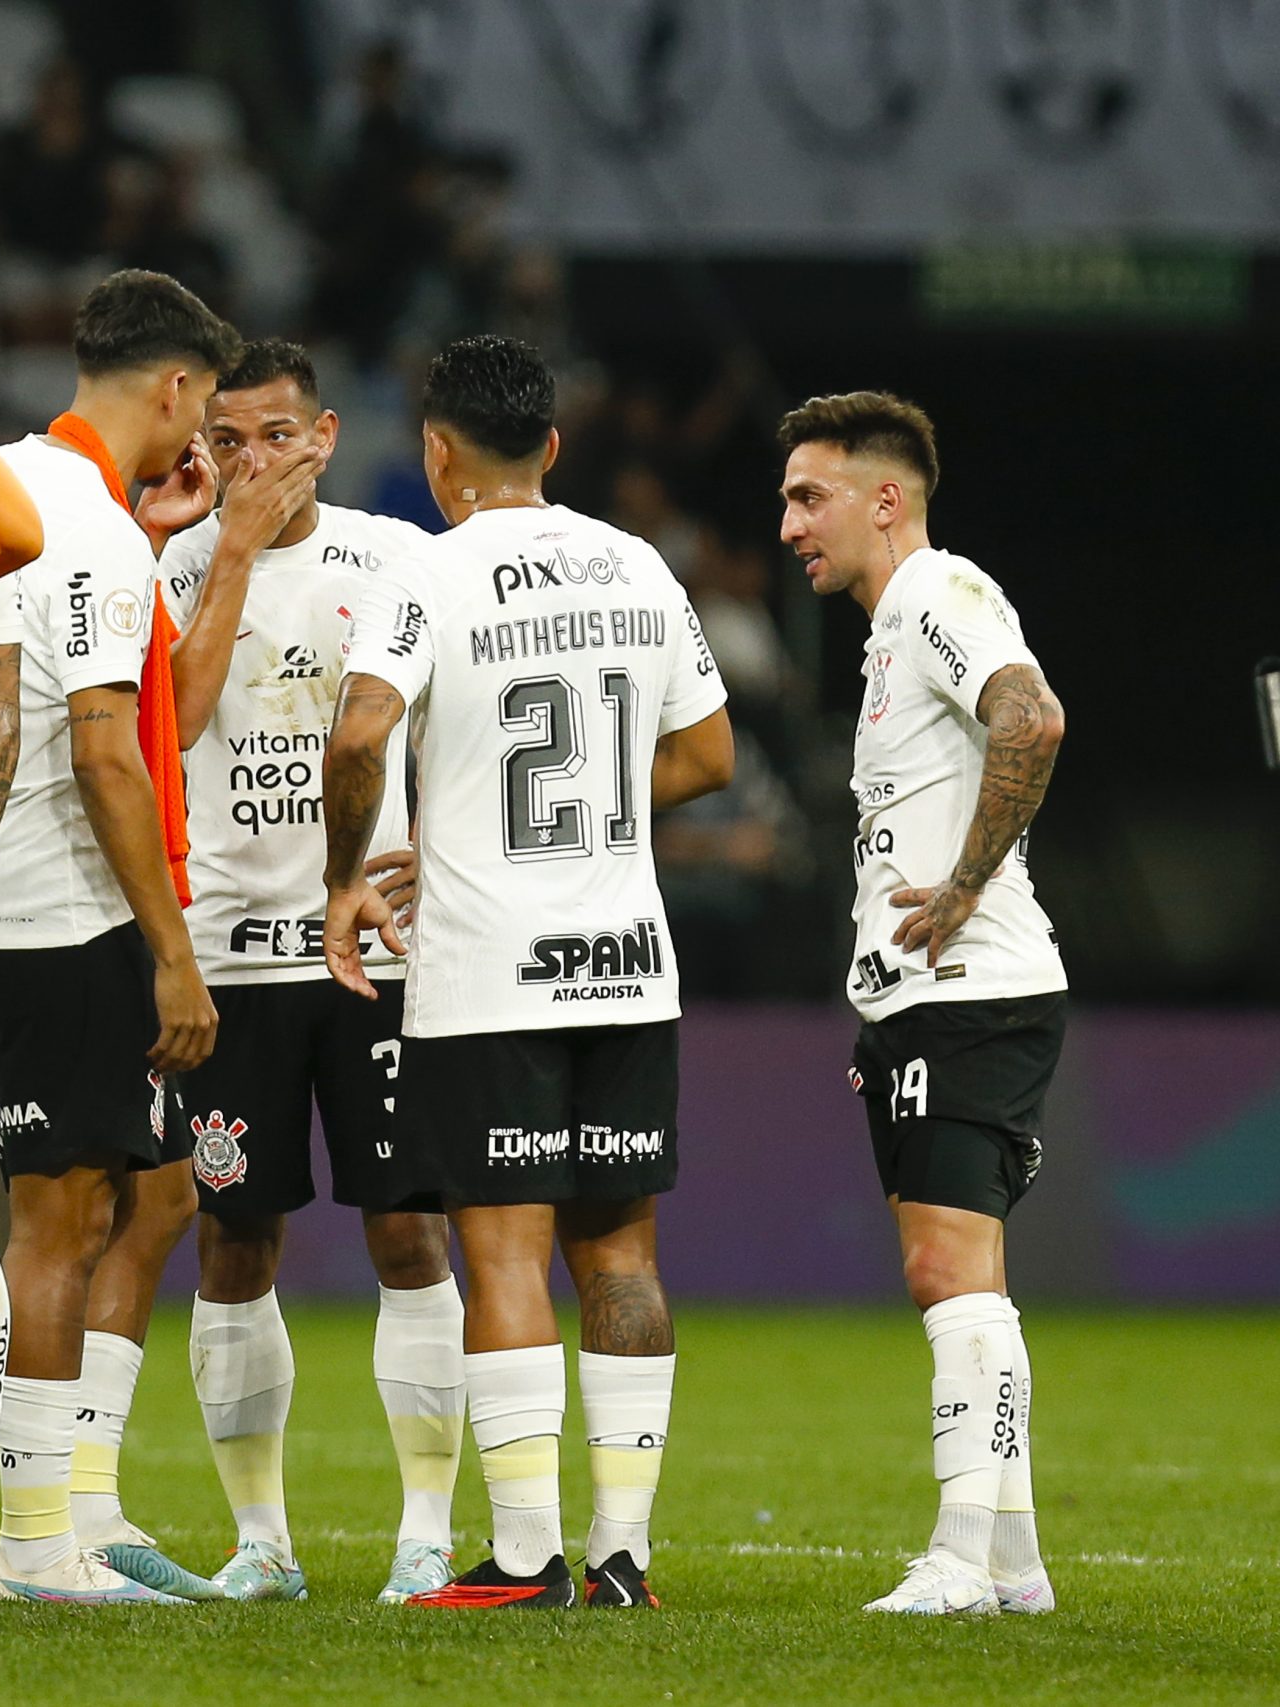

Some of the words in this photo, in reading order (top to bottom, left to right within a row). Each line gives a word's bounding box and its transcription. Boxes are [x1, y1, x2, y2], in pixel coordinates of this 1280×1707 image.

[493, 547, 631, 604] pixbet
[66, 592, 93, 659] bmg
[470, 610, 604, 666] MATHEUS
[610, 608, 666, 648] BIDU
[277, 667, 324, 680] ALE
[929, 623, 967, 687] bmg
[228, 726, 328, 756] vitami
[230, 761, 312, 791] neo
[498, 667, 640, 864] 21
[231, 789, 323, 836] quím
[552, 985, 644, 1002] ATACADISTA
[489, 1127, 523, 1136] GRUPO
[580, 1123, 612, 1134] GRUPO
[991, 1365, 1013, 1455] TODOS
